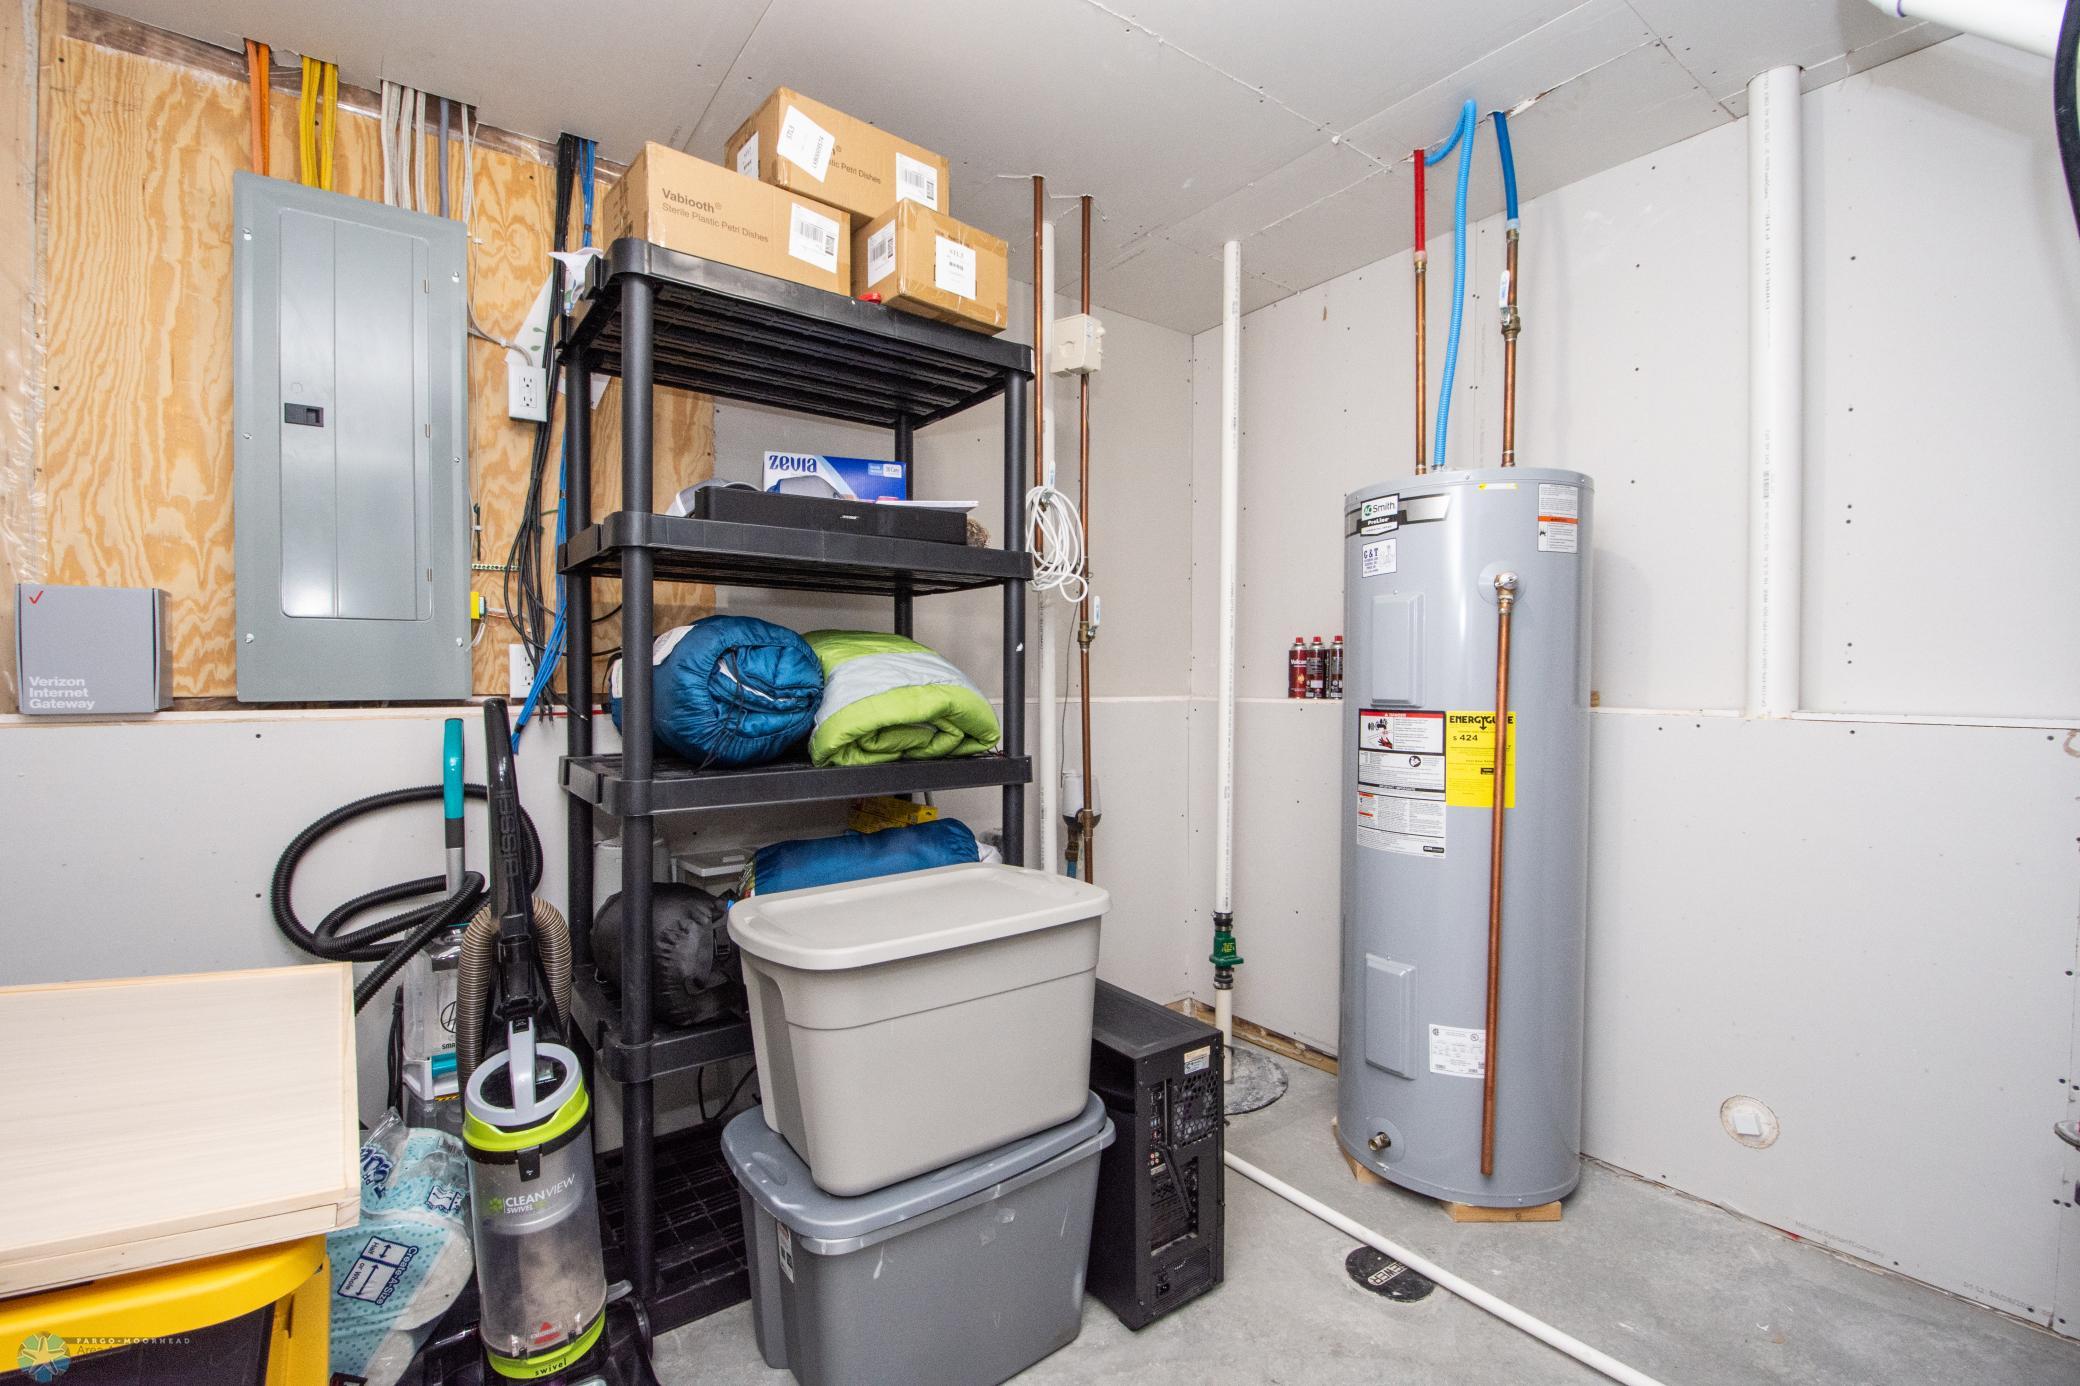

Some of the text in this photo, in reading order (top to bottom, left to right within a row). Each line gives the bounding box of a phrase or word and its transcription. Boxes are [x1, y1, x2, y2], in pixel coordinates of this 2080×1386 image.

[662, 203, 769, 242] Sterile Plastic Petri Dishes
[1373, 502, 1395, 513] Smith
[28, 676, 85, 687] Verizon
[29, 688, 88, 698] Internet
[30, 699, 95, 710] Gateway
[1460, 733, 1478, 741] 424
[507, 1203, 533, 1214] SWIVEL
[367, 1241, 379, 1255] Half
[345, 1271, 361, 1290] Whole
[376, 1246, 419, 1305] Create-A-Size
[535, 1358, 567, 1376] swivel
